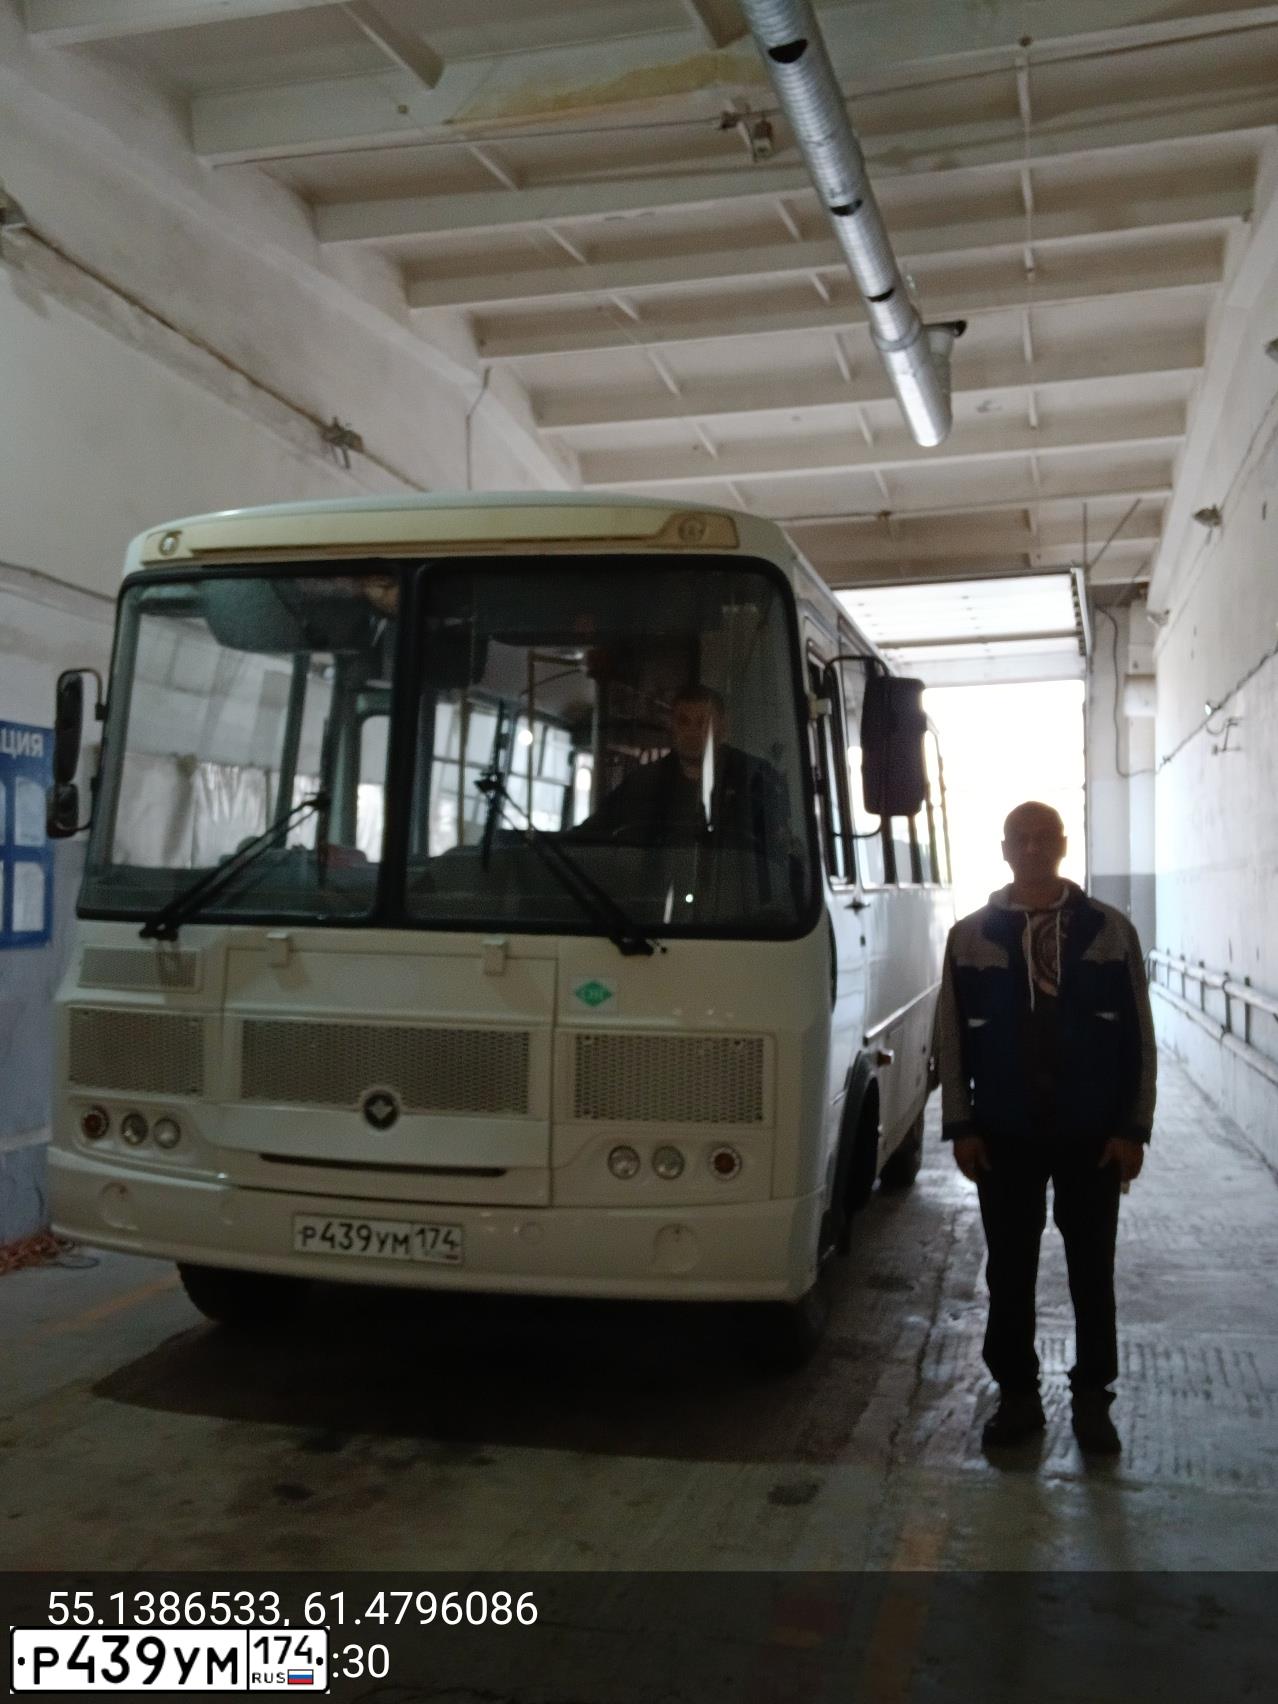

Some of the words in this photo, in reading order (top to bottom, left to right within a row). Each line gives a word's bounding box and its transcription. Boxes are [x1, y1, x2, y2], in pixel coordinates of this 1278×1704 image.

[0, 728, 44, 758] ЦИЯ
[302, 1221, 409, 1254] Р439УМ
[415, 1227, 458, 1251] 174
